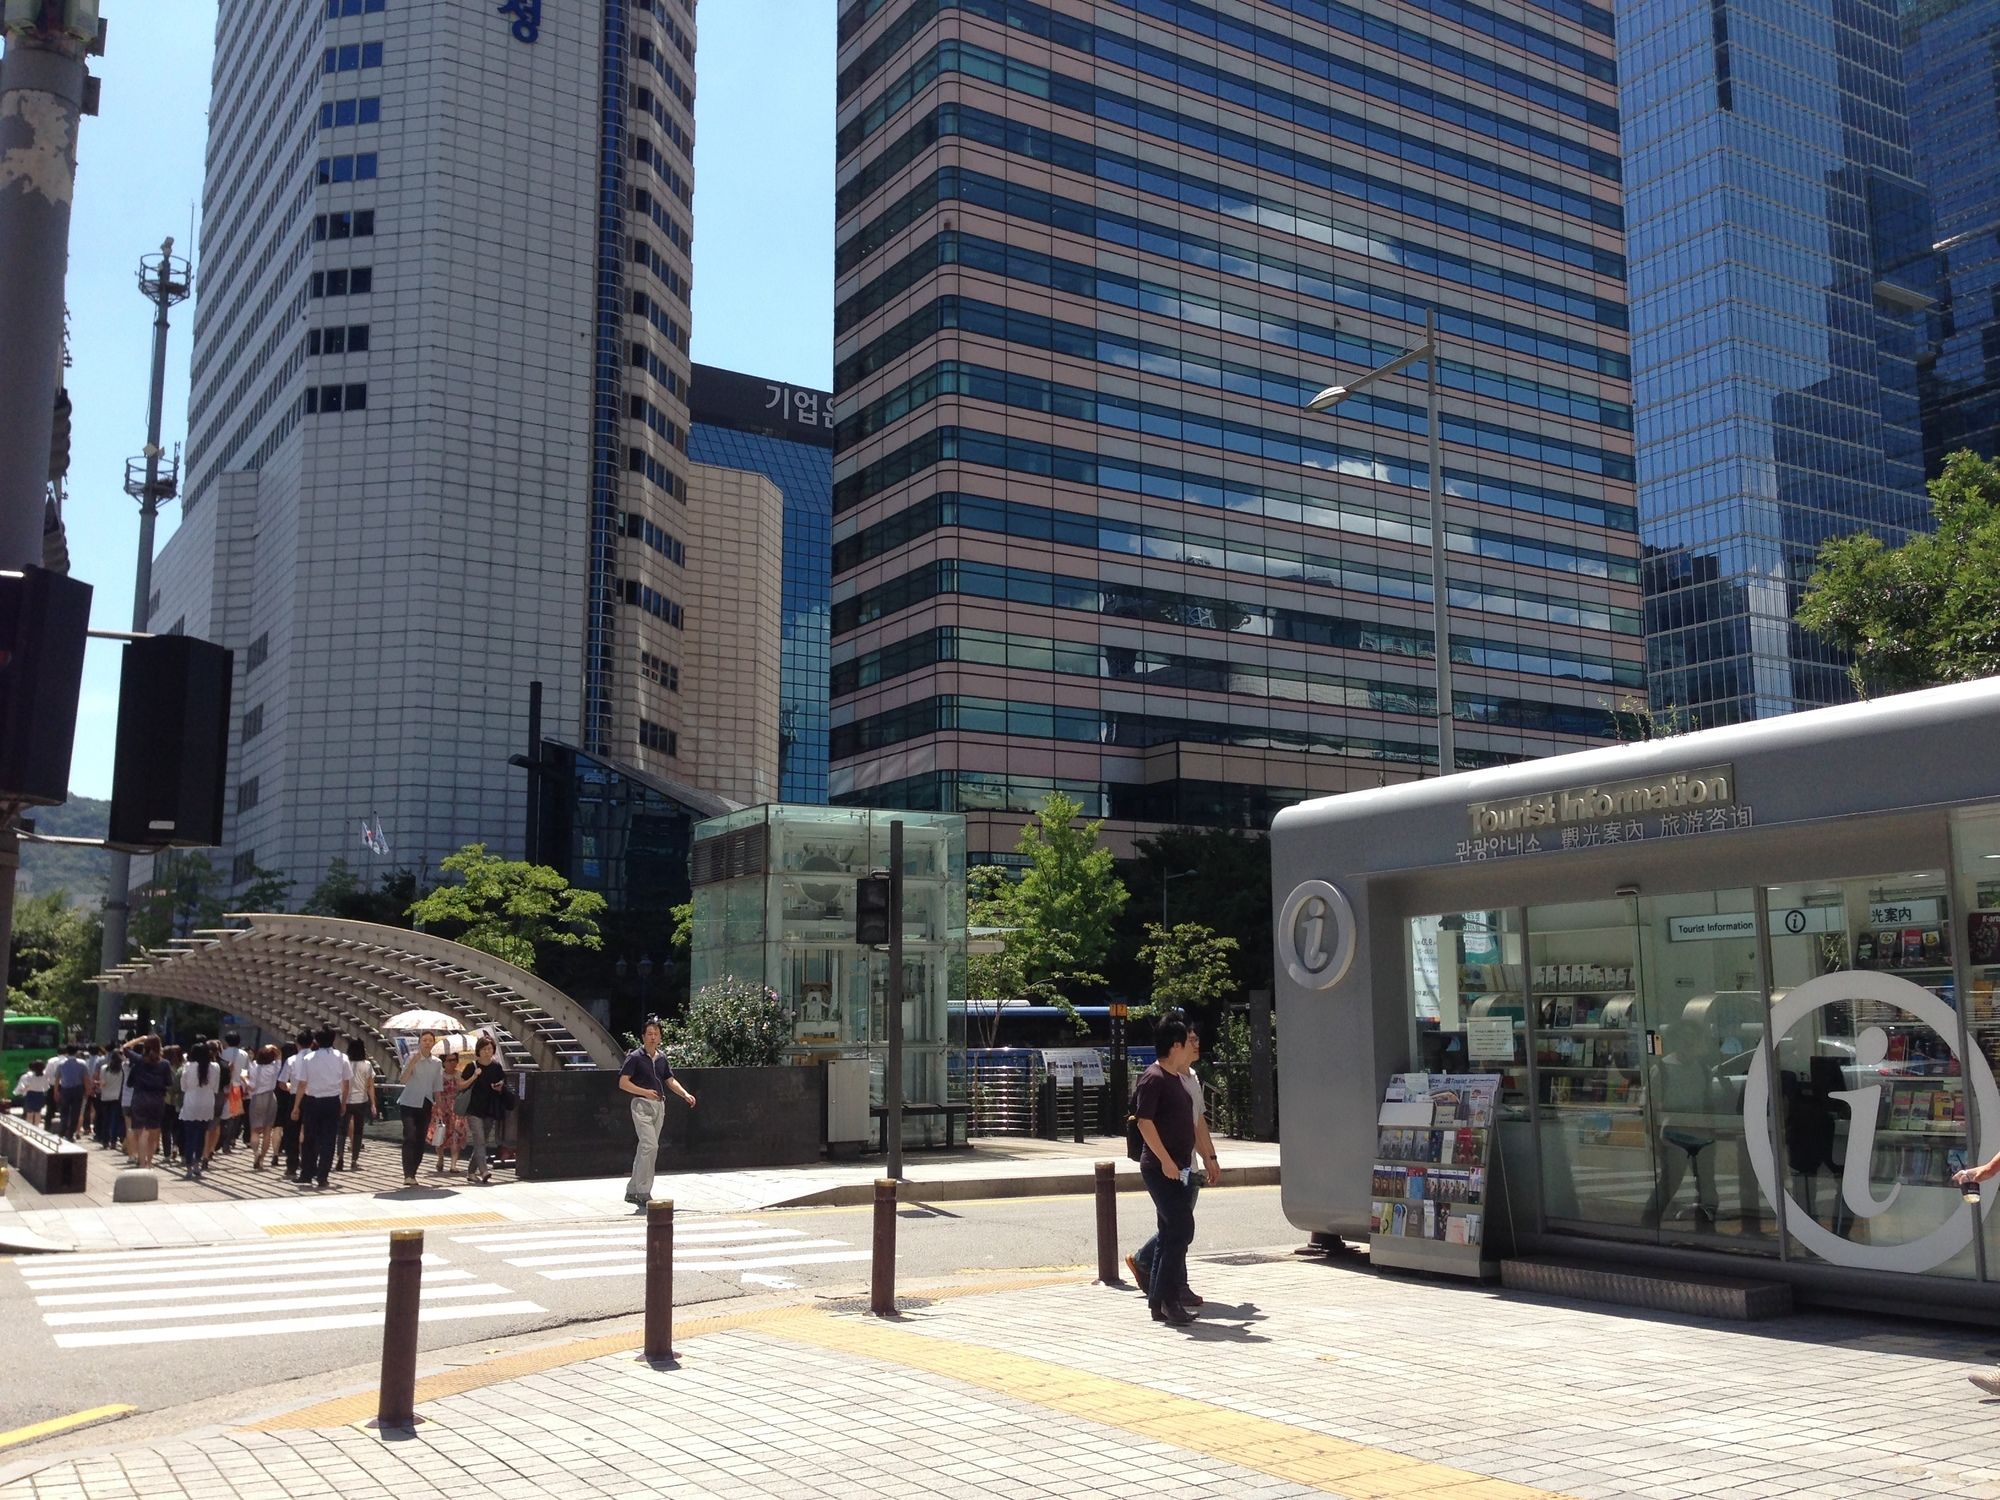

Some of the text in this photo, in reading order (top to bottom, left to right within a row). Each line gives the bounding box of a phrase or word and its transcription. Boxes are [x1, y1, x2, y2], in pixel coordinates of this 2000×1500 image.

[1456, 832, 1543, 863] 관광안내소
[1660, 803, 1753, 838] 旅游咨询
[1467, 775, 1729, 836] Tourist Information
[1678, 920, 1754, 934] Tourist Information
